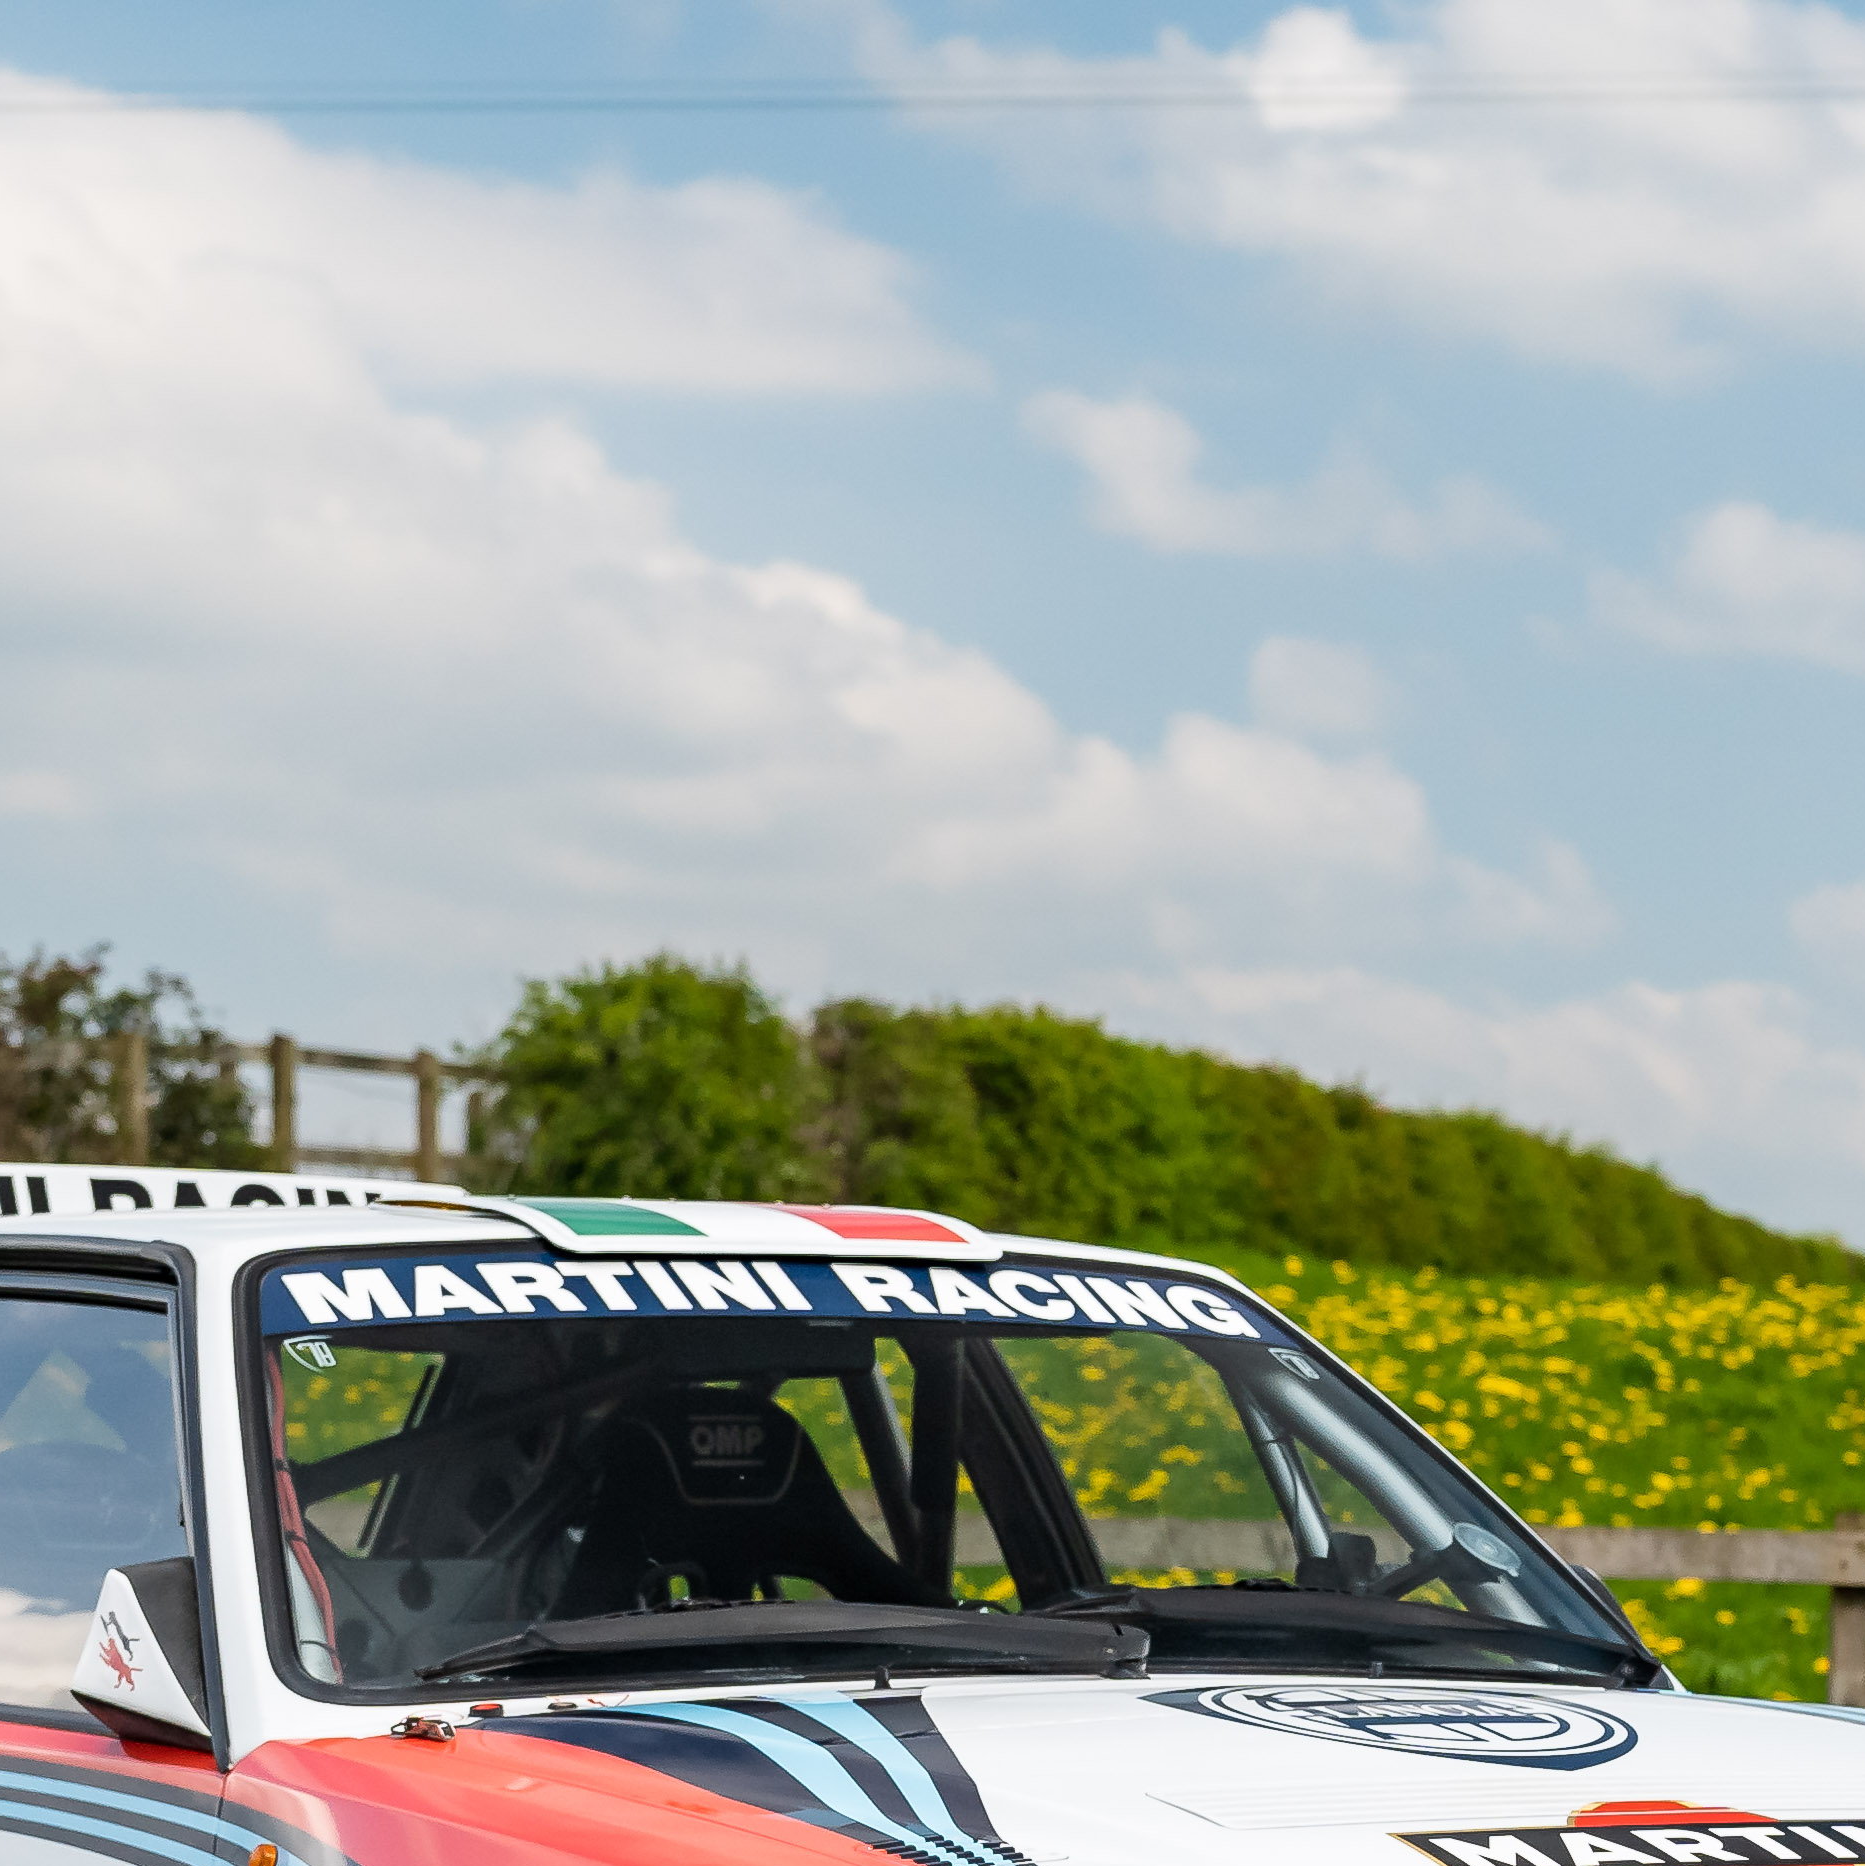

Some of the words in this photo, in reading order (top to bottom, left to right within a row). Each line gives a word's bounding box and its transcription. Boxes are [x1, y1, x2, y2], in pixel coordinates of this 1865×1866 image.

[281, 1260, 813, 1324] MARTINI
[831, 1263, 1262, 1338] RACING
[690, 1424, 764, 1455] OMP
